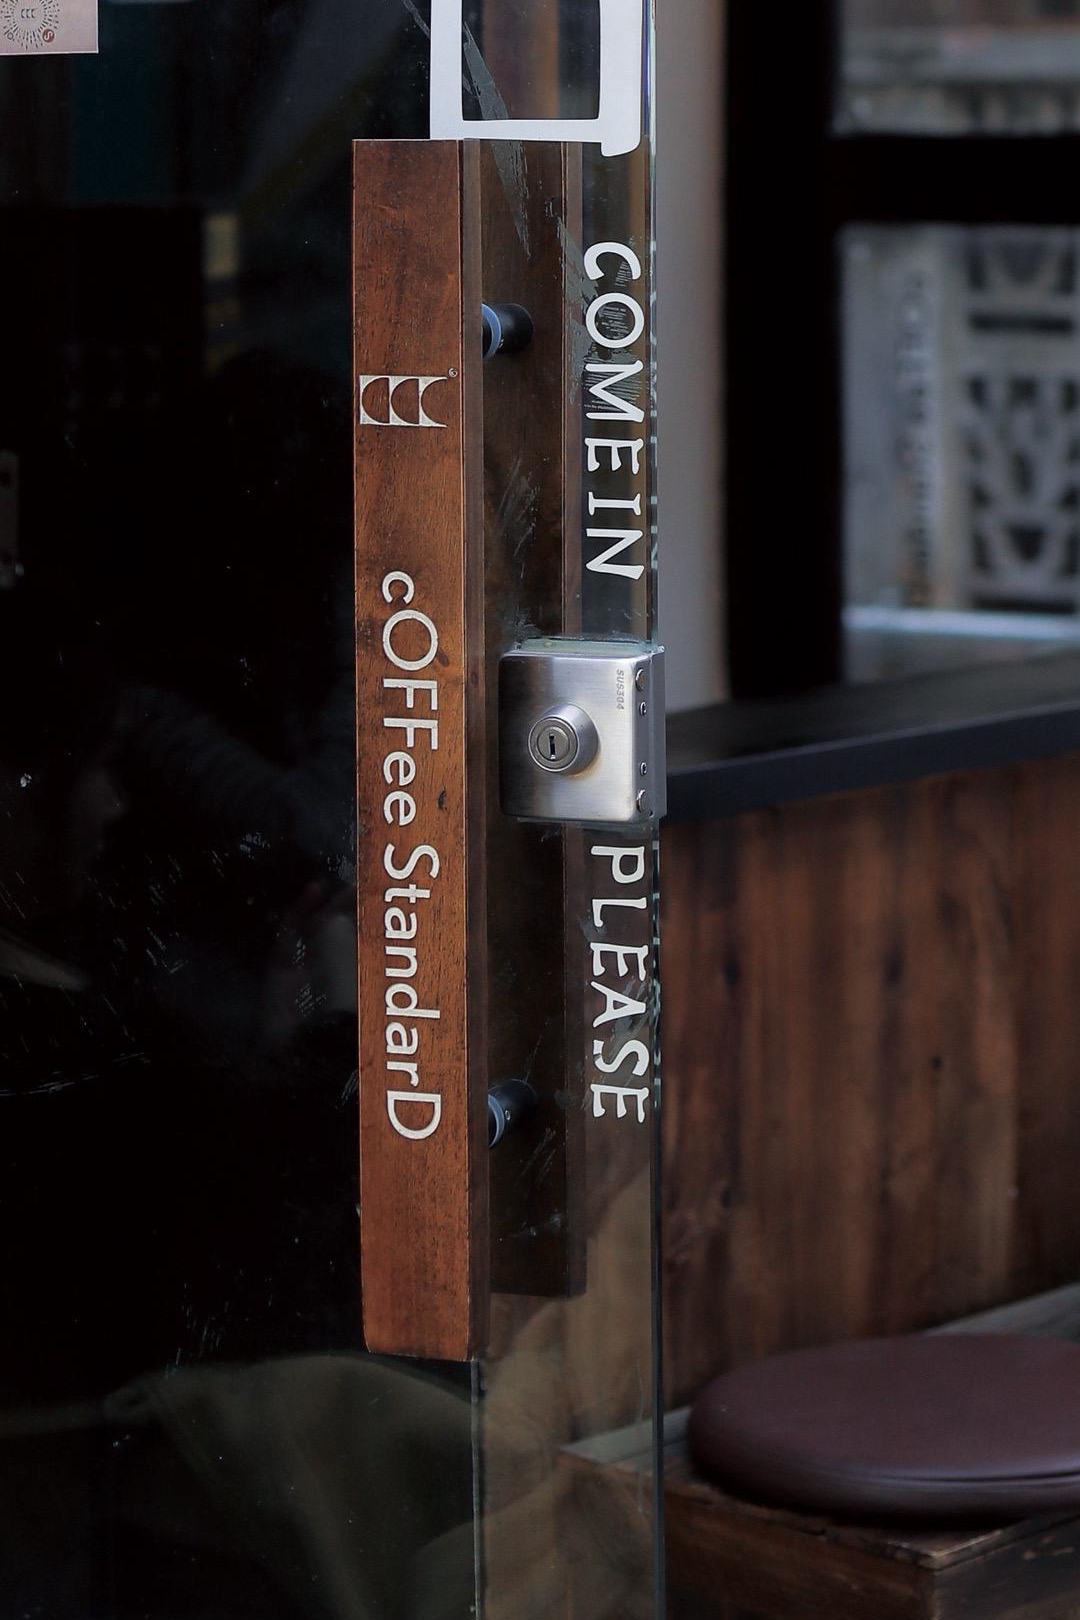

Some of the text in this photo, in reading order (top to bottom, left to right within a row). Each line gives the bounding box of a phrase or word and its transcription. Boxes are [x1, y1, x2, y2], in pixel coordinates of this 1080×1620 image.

[616, 669, 625, 710] SUS304
[382, 570, 441, 1141] cOFFee StandarD
[590, 844, 651, 1124] PLEASE
